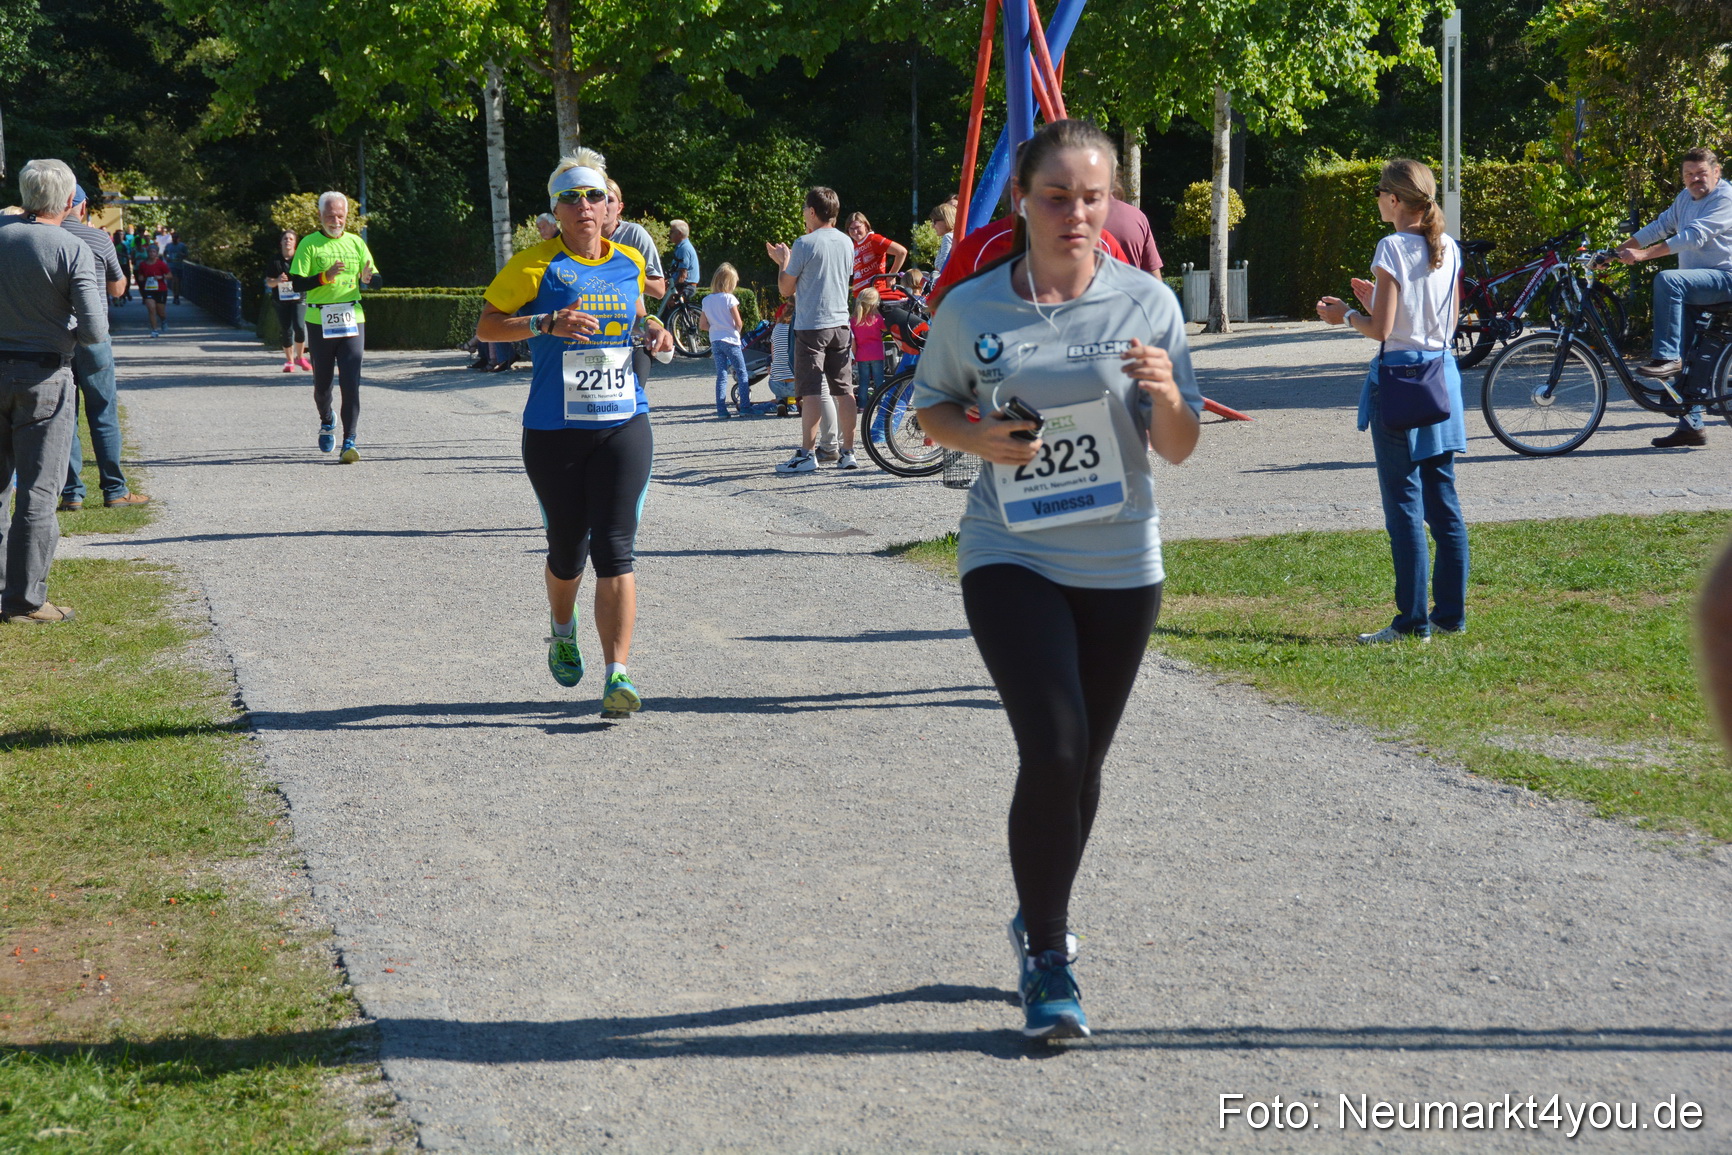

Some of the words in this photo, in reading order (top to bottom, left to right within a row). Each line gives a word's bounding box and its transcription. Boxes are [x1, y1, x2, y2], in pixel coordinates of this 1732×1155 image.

[326, 312, 351, 324] 2510
[1067, 341, 1132, 358] BOCK
[575, 368, 625, 391] 2215
[587, 403, 619, 413] Claudia
[1023, 483, 1049, 493] PARTL
[1050, 476, 1088, 489] Neumarkt
[1031, 494, 1095, 515] Vanessa
